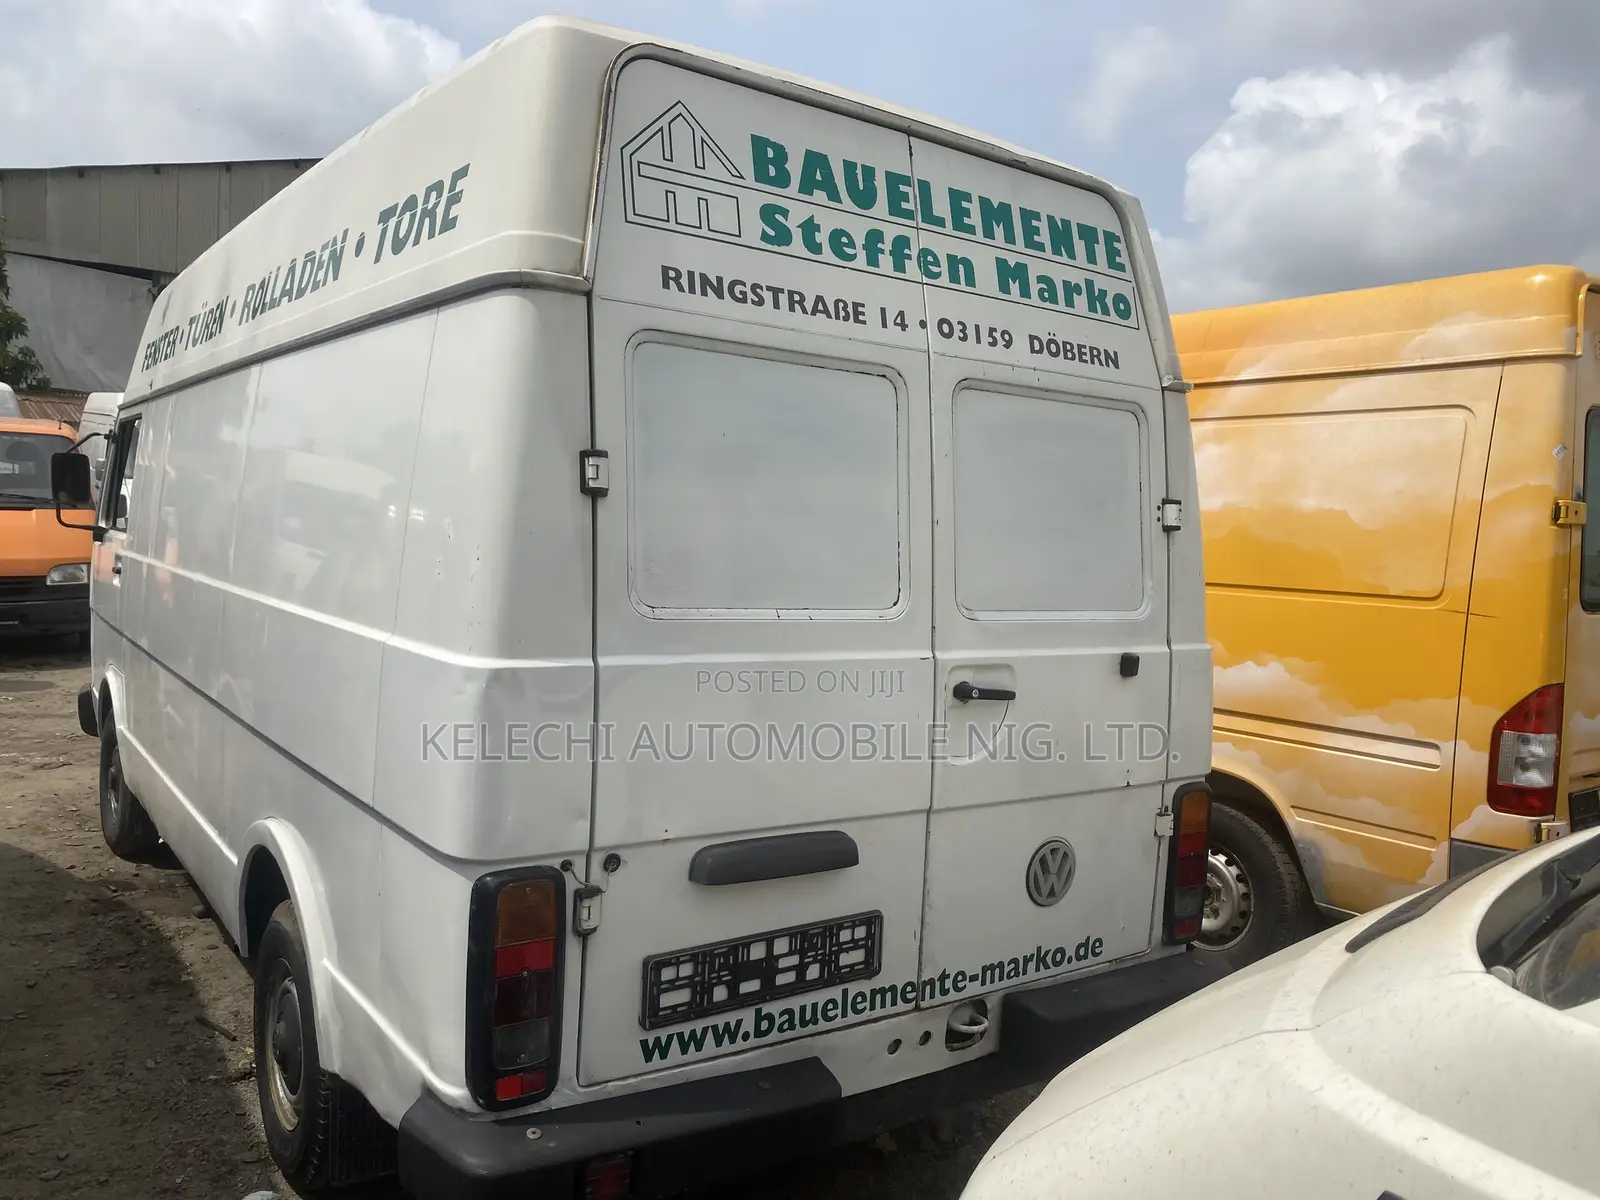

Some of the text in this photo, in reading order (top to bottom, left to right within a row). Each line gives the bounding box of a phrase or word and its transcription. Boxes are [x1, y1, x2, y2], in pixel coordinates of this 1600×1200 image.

[750, 133, 1126, 272] BAUELEMENTE
[759, 203, 1131, 321] Steffen Marko
[141, 163, 470, 372] FENSTER TÜREN ROLLADEN TORE
[878, 307, 909, 332] 14
[937, 316, 1013, 351] 03159
[1029, 331, 1120, 370] DÖBERN
[639, 935, 1104, 1064] www.bauelemente-marko.de
